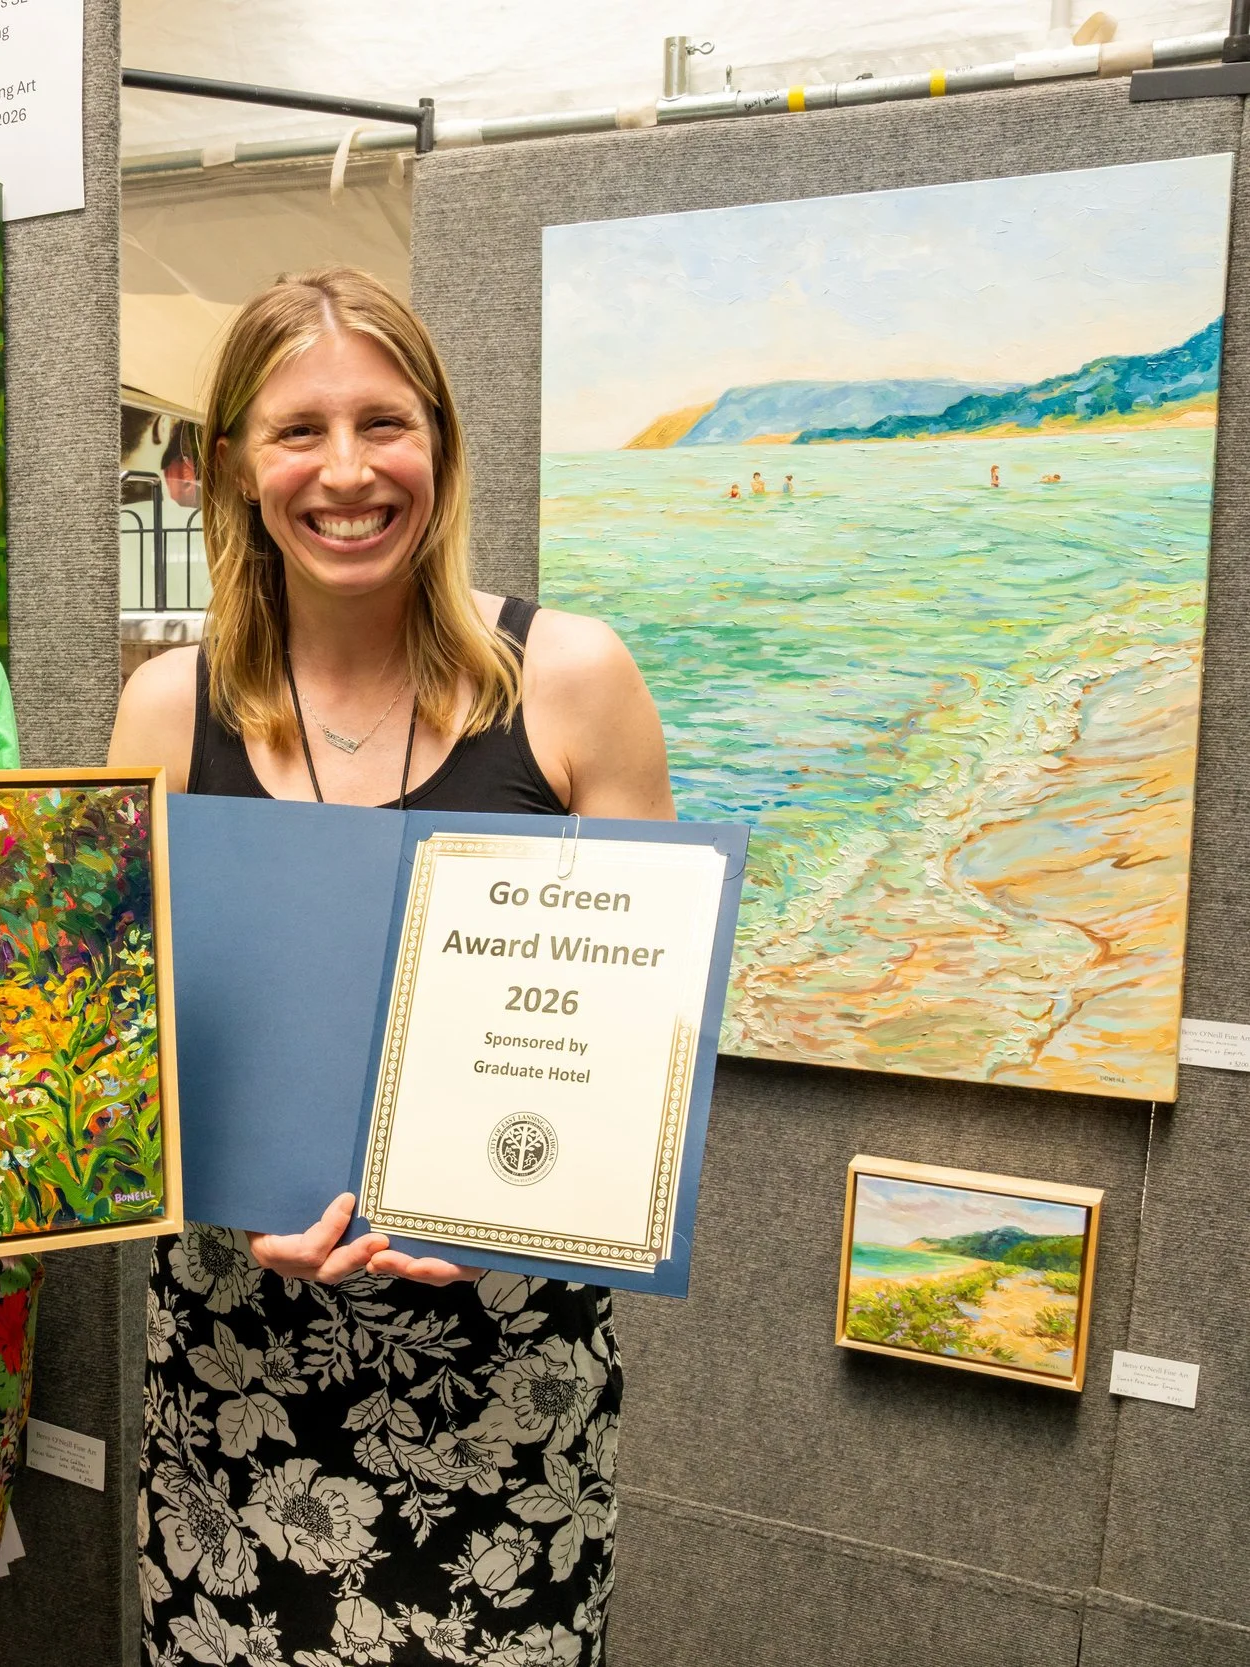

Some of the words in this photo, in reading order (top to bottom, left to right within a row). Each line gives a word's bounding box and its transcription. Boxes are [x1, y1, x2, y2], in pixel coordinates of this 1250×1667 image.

[16, 79, 37, 95] Art
[489, 881, 530, 906] Go
[539, 883, 631, 912] Green
[442, 929, 540, 959] Award
[550, 935, 665, 967] Winner
[505, 986, 579, 1016] 2026
[484, 1031, 565, 1053] Sponsored
[569, 1038, 588, 1056] by
[473, 1060, 544, 1080] Graduate
[548, 1067, 591, 1084] Hotel
[501, 1116, 516, 1128] EAST
